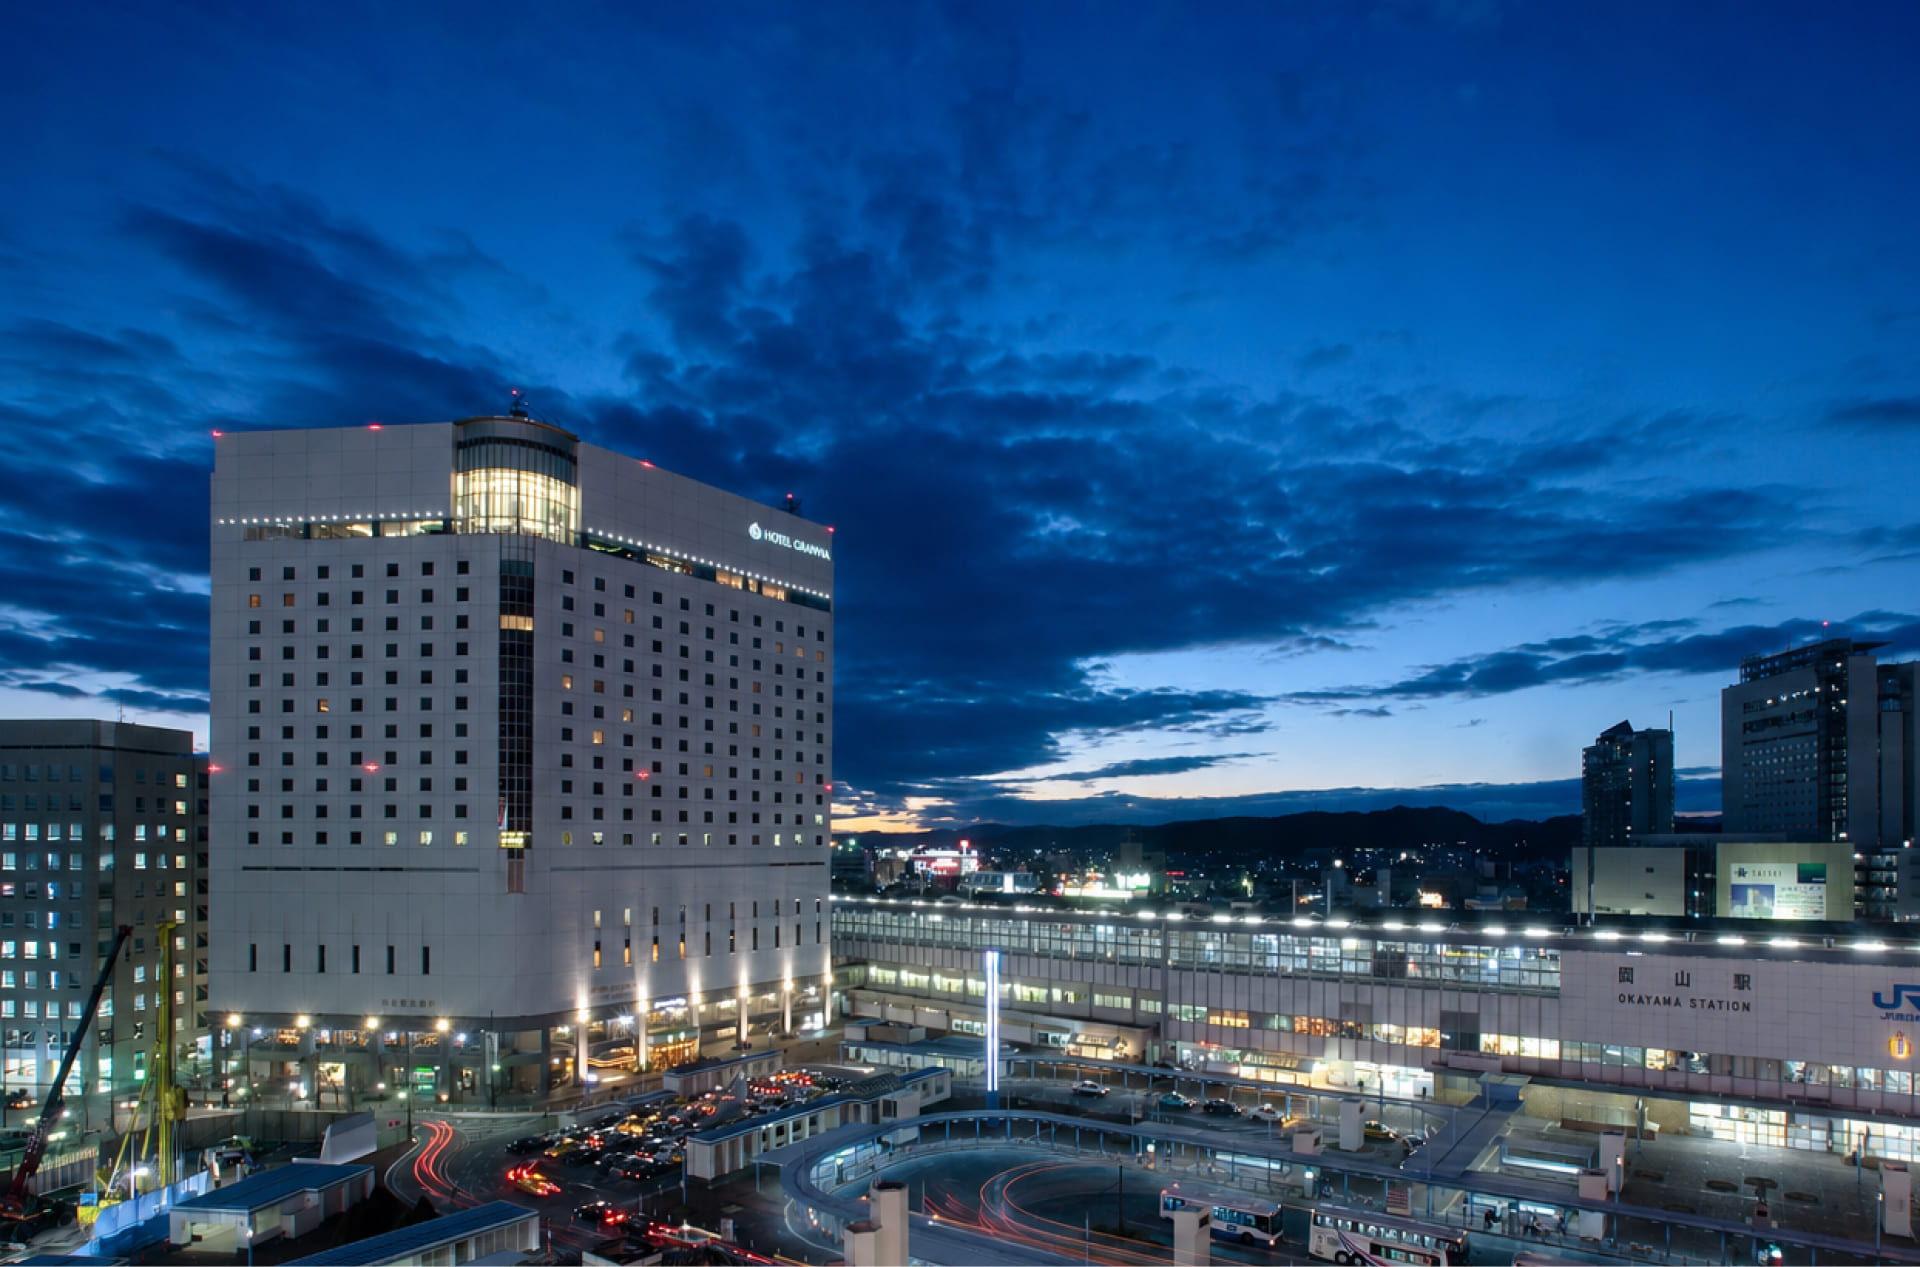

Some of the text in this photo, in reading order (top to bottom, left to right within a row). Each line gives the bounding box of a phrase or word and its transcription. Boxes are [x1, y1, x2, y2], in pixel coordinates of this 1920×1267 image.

[764, 529, 792, 547] HOTEL
[1618, 993, 1751, 1012] OKAYAMA STATION
